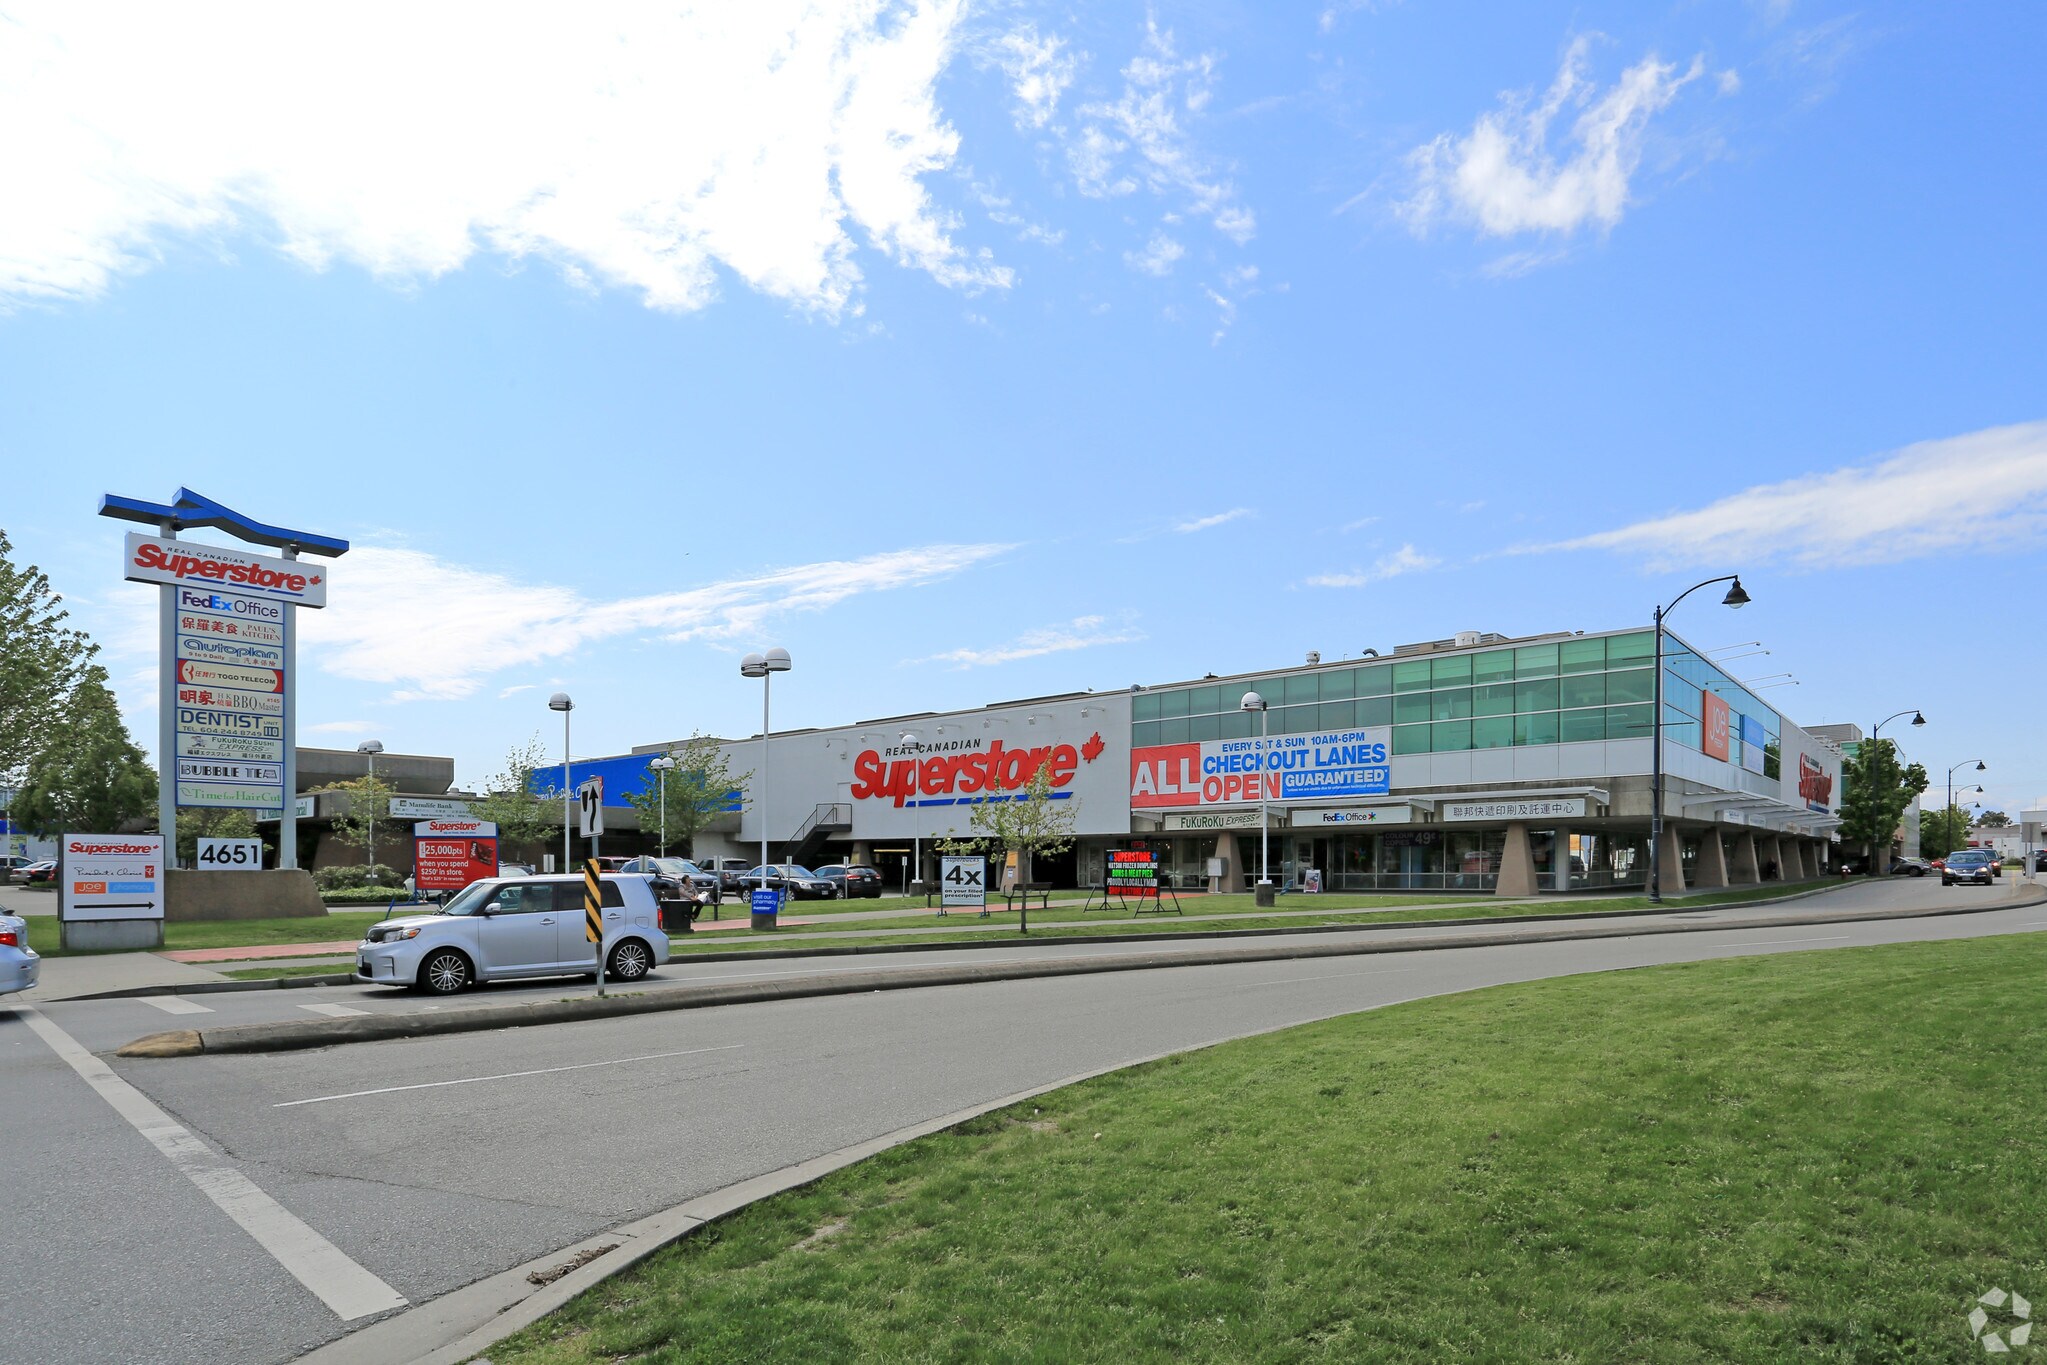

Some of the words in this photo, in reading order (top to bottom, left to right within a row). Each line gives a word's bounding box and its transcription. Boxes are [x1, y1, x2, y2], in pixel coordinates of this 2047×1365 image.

[167, 547, 192, 556] REAL
[196, 552, 246, 564] CANADIAN
[134, 544, 307, 591] Superstore
[182, 591, 232, 611] FedEx
[234, 600, 278, 618] Office
[182, 617, 238, 635] 保羅美食
[247, 624, 276, 634] PAUL'S
[242, 630, 281, 641] KITCHEN
[209, 653, 225, 661] Daily
[217, 673, 239, 681] TOGO
[240, 675, 276, 685] TELECOM
[258, 702, 280, 712] Master
[180, 710, 263, 729] DENTIST
[264, 726, 279, 737] 110
[218, 743, 265, 752] EXPRESS
[253, 739, 275, 747] SUSHI
[918, 738, 981, 754] CANADIAN
[1222, 741, 1252, 753] EVERY
[1255, 739, 1273, 751] SAT
[1275, 738, 1283, 748] &
[1285, 737, 1306, 748] SUN
[1311, 731, 1366, 746] 10AM-6PM
[1203, 749, 1308, 774] CHECKOUT
[1315, 743, 1386, 767] LANES
[180, 764, 239, 778] BUBBLE
[245, 767, 278, 779] TEA
[851, 739, 1078, 808] Superstore
[1131, 757, 1201, 797] ALL
[1203, 772, 1281, 802] OPEN
[1453, 801, 1575, 817] 聯邦快遞印刷及託運中心
[1323, 812, 1345, 822] FedEx
[1345, 812, 1367, 822] Office
[429, 821, 477, 832] Superstore
[68, 841, 152, 855] Superstore
[200, 844, 258, 864] 4651
[1113, 851, 1152, 863] SUPERSTORE
[450, 860, 469, 869] spend
[74, 866, 114, 876] President's
[116, 867, 142, 876] Choice
[439, 868, 446, 876] in
[1128, 869, 1141, 878] MEAT
[1141, 870, 1154, 879] PIES
[113, 884, 151, 892] pharmacy
